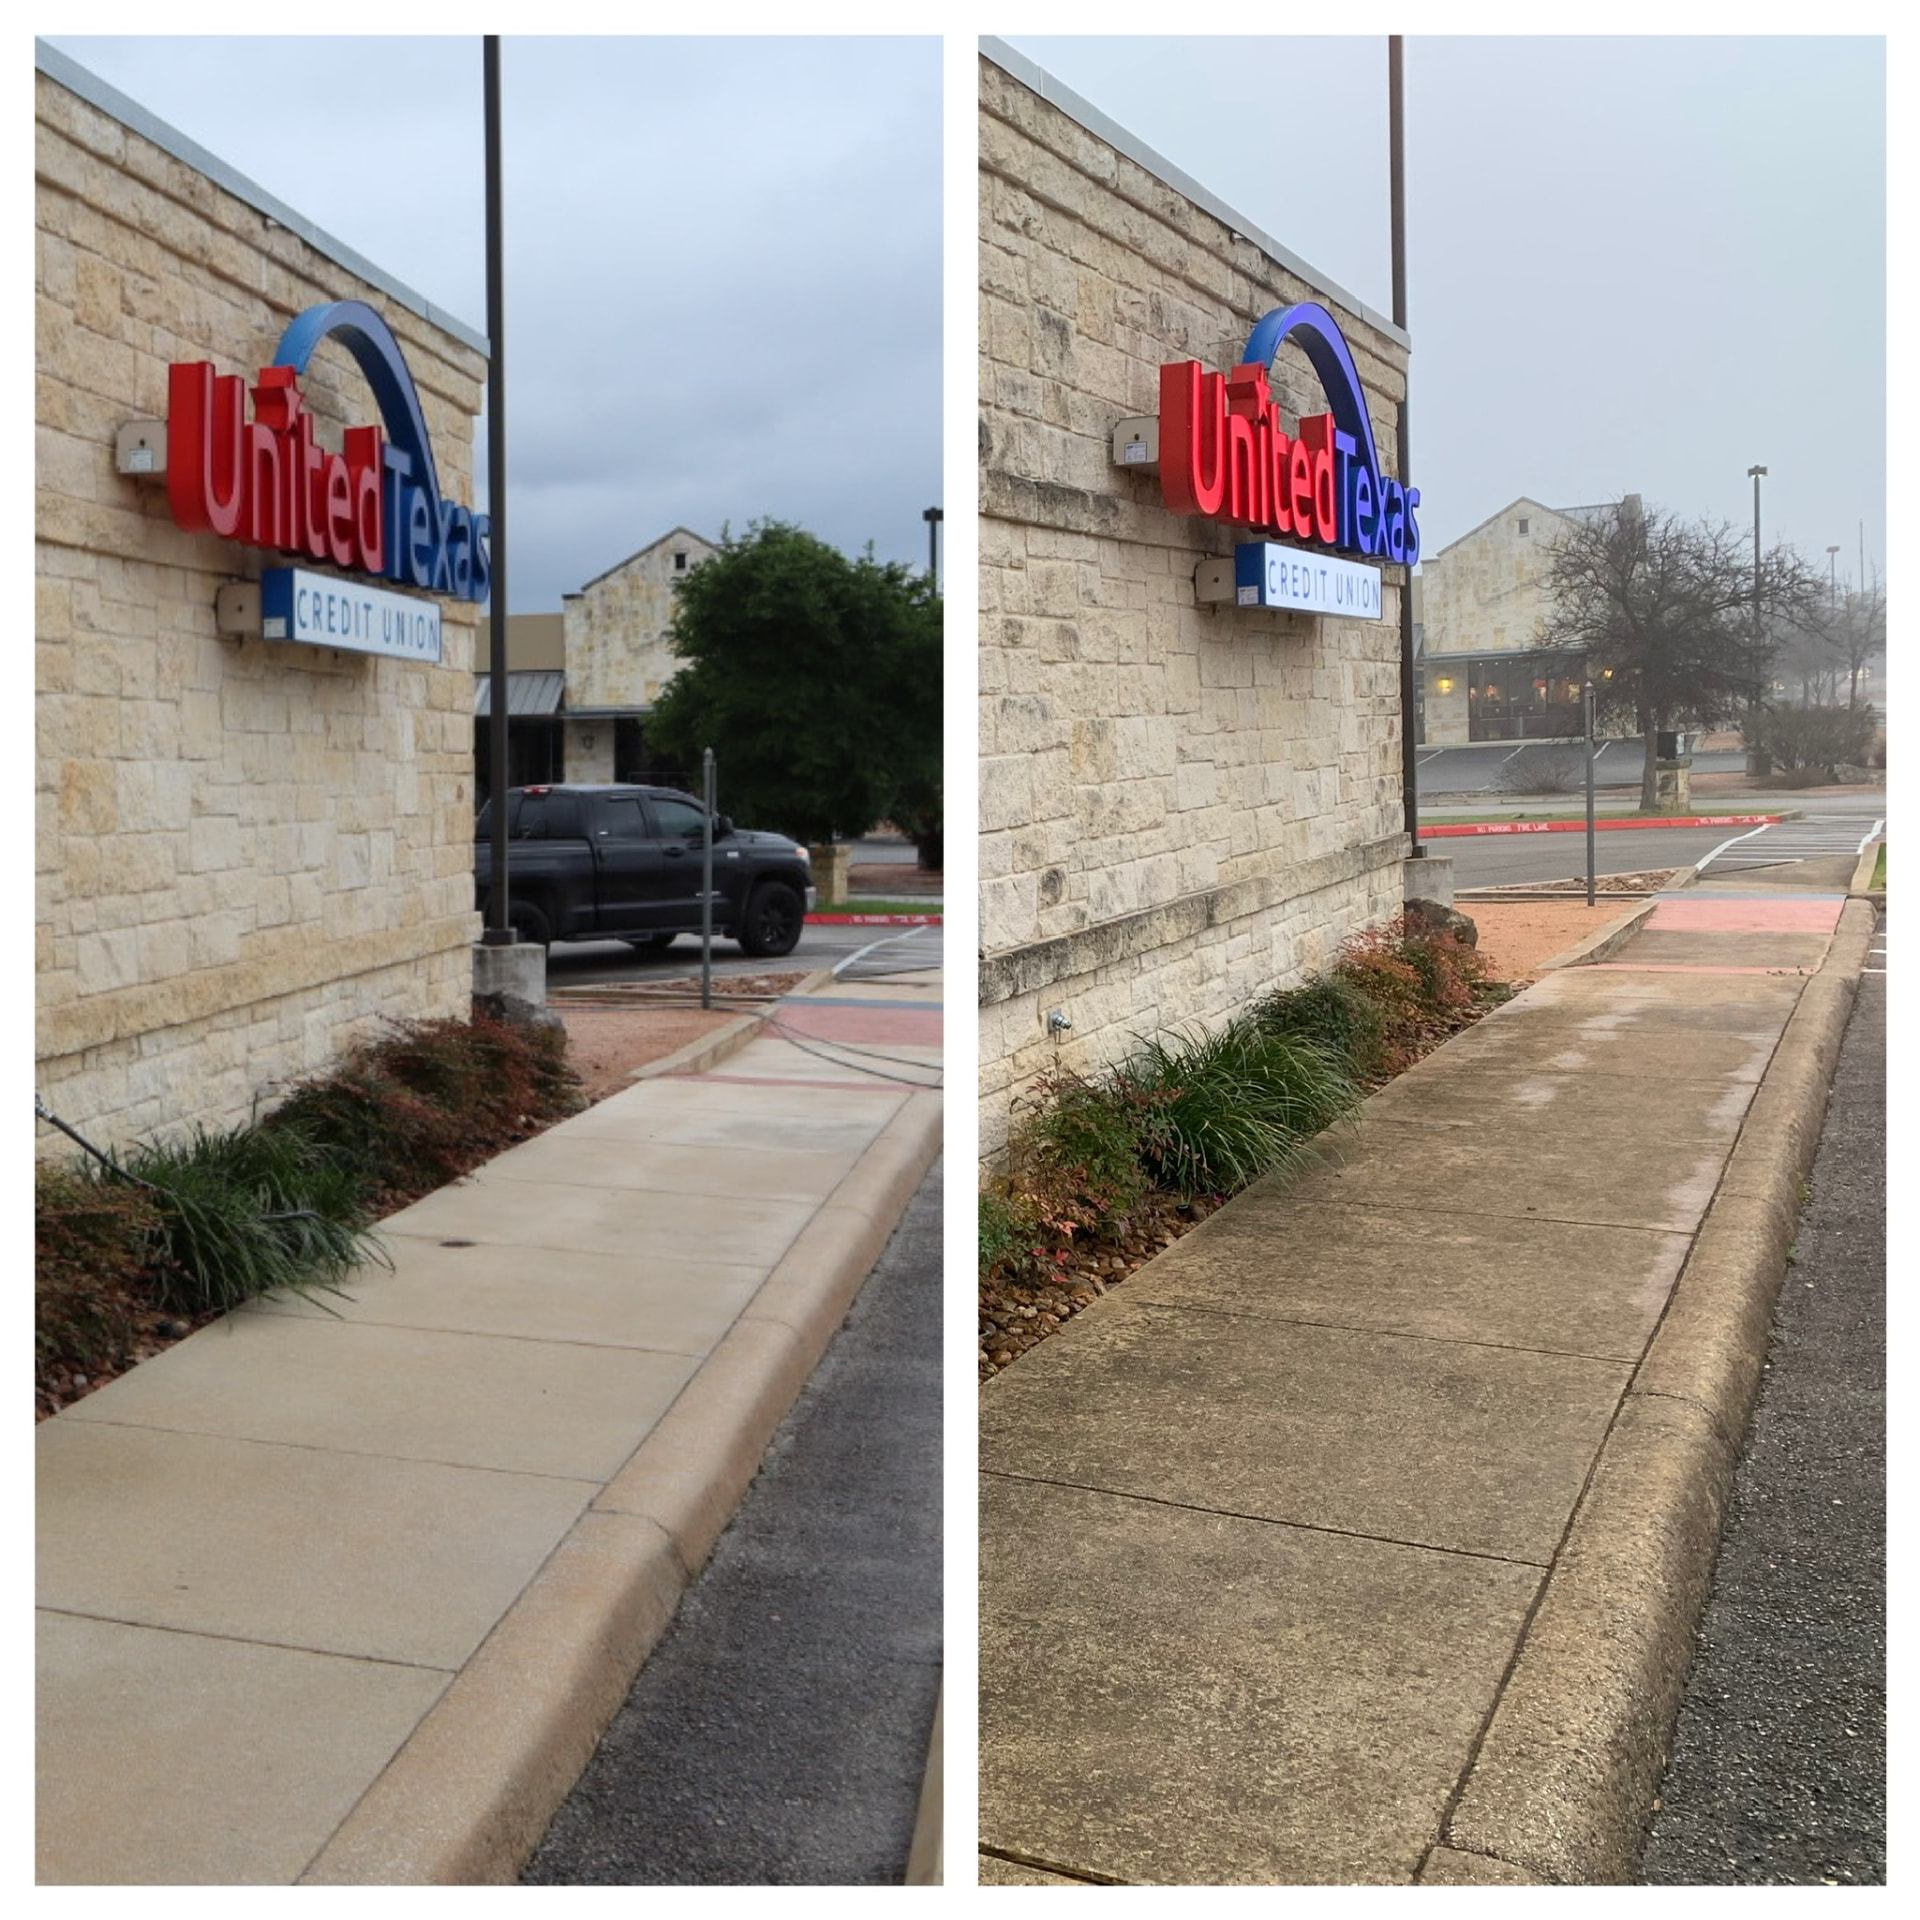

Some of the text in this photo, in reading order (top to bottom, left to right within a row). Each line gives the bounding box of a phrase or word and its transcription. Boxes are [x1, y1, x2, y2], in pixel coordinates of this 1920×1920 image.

[1268, 560, 1328, 602] CREDIT
[1337, 572, 1380, 611] UNION
[297, 586, 372, 640] CREDIT
[383, 607, 437, 651] UNION
